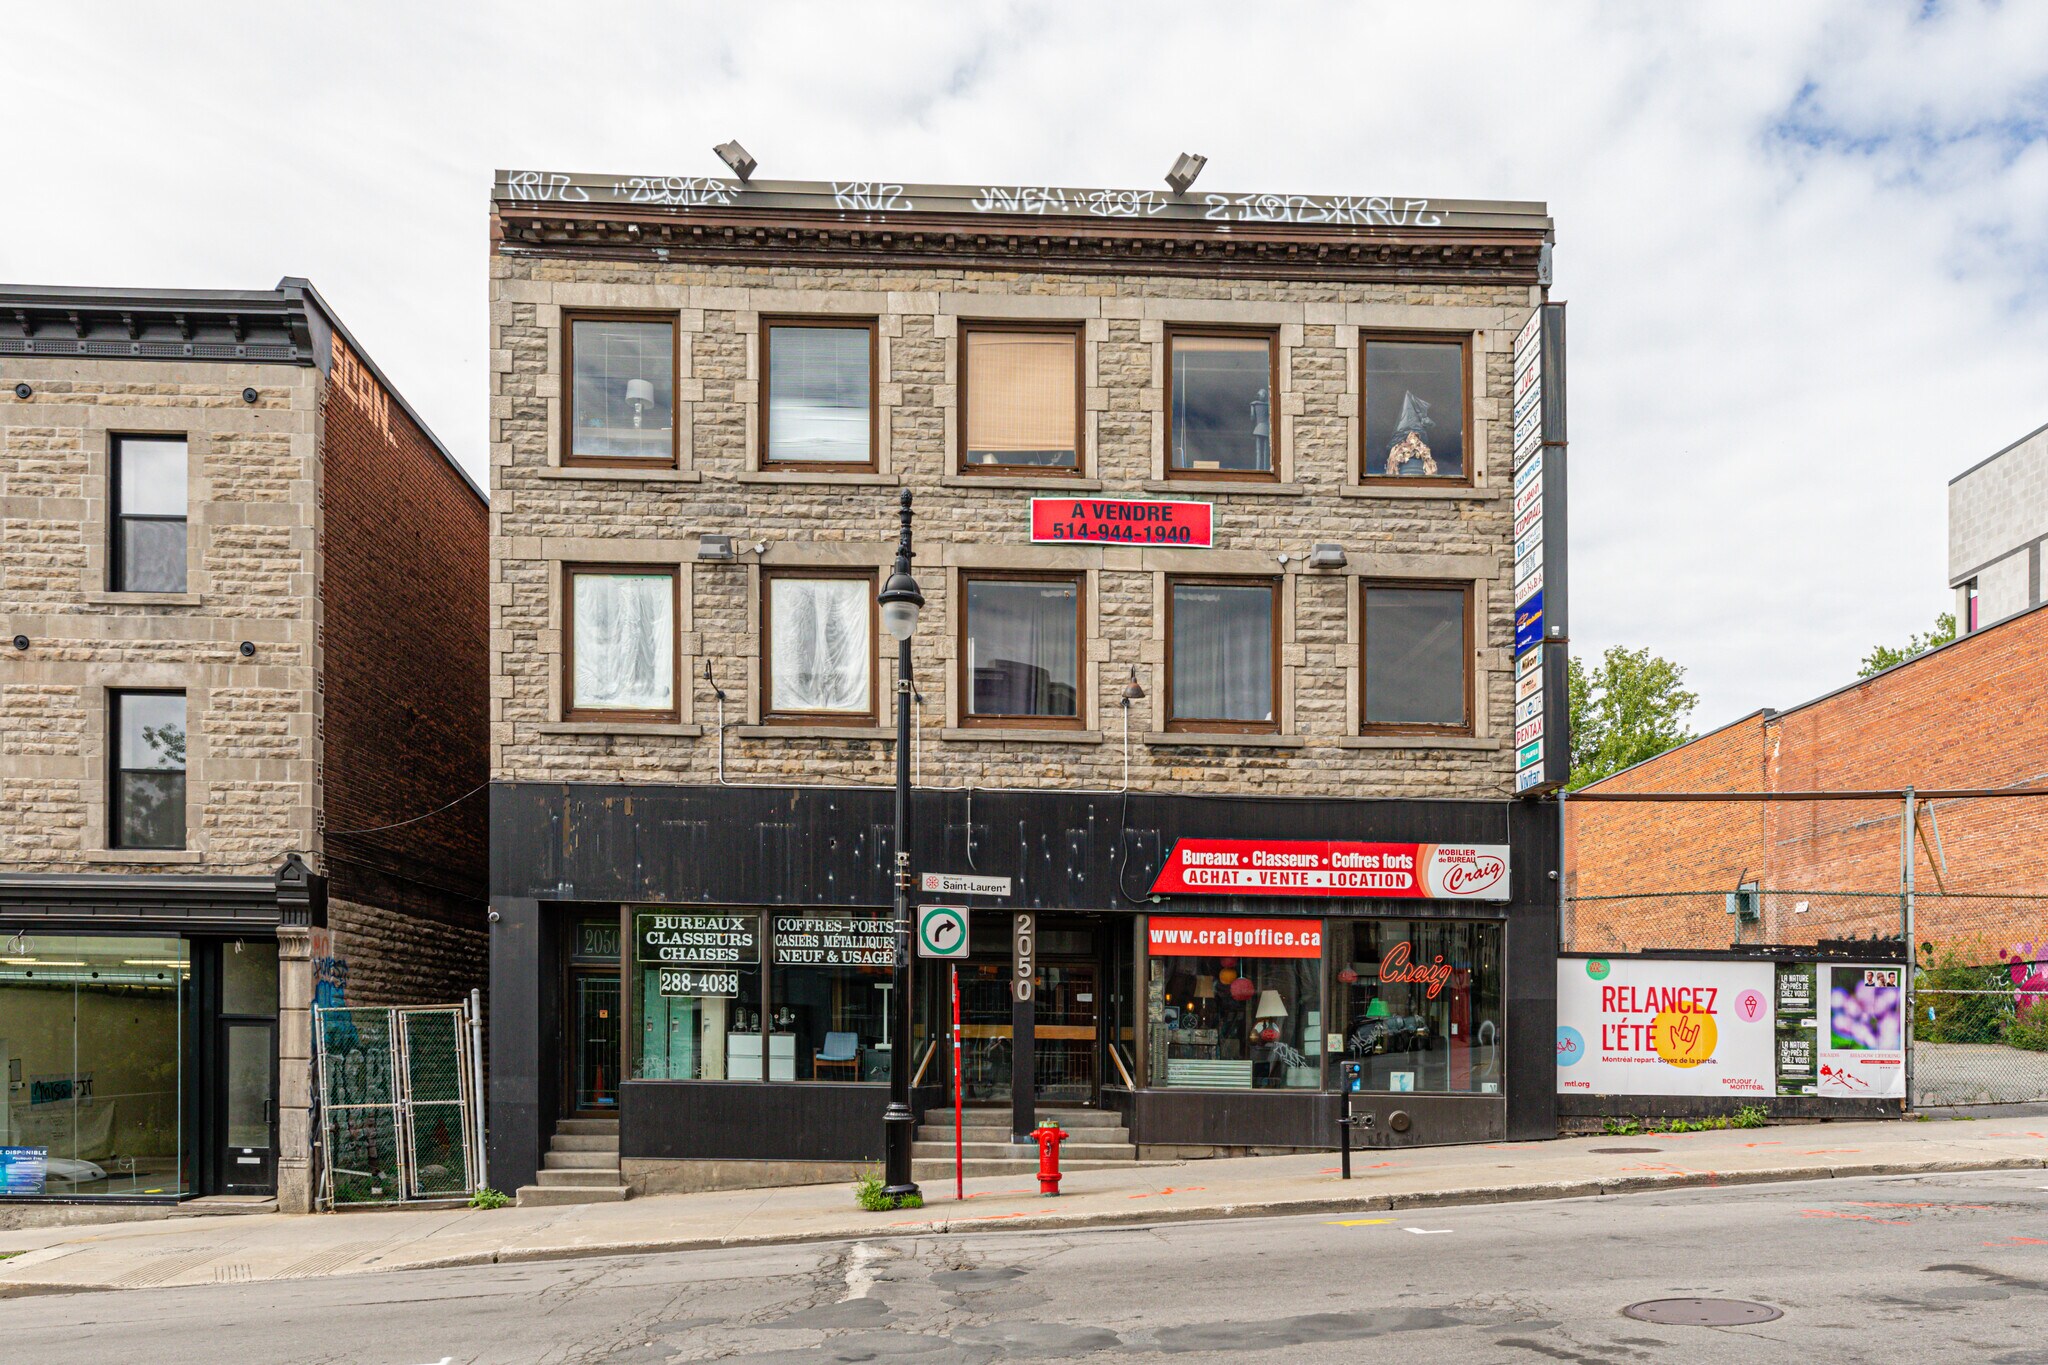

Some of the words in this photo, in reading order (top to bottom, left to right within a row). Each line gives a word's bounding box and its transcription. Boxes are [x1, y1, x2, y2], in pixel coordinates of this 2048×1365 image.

[1519, 366, 1534, 395] JVC
[1516, 409, 1539, 443] SONY
[1516, 456, 1541, 489] OLYMPUS
[1071, 501, 1085, 518] À
[1092, 503, 1173, 521] VENDRE
[1516, 502, 1541, 536] COMPAQ
[1053, 522, 1191, 543] 514-944-1940
[1522, 551, 1536, 578] IBM
[1516, 718, 1543, 745] PENTAX
[1520, 769, 1540, 790] Vivitar
[1182, 849, 1239, 866] Bureaux
[1252, 850, 1319, 868] Classeurs
[1331, 851, 1380, 869] Coffres
[1382, 853, 1414, 870] forts
[1438, 848, 1476, 856] MOBILIER
[1188, 870, 1240, 884] ACHAT
[1259, 871, 1309, 886] VENTE
[1328, 873, 1406, 887] LOCATION
[1449, 862, 1501, 890] Craig
[654, 916, 745, 931] BUREAUX
[777, 918, 894, 934] COFFRES-FORTS
[646, 931, 753, 946] CLASSEURS
[775, 934, 819, 948] CASIERS
[823, 933, 895, 950] MÉTALLIQUES
[1150, 928, 1321, 947] www.craigoffice.ca
[659, 947, 739, 961] CHAISES
[778, 949, 824, 963] NEUF
[826, 950, 839, 963] &
[1017, 914, 1032, 1001] 2050
[1380, 941, 1453, 999] Craig
[661, 972, 738, 993] 288-4038
[1602, 985, 1718, 1015] RELANCEZ
[1657, 1056, 1678, 1065] Soyez
[1564, 1080, 1590, 1089] mtl.org
